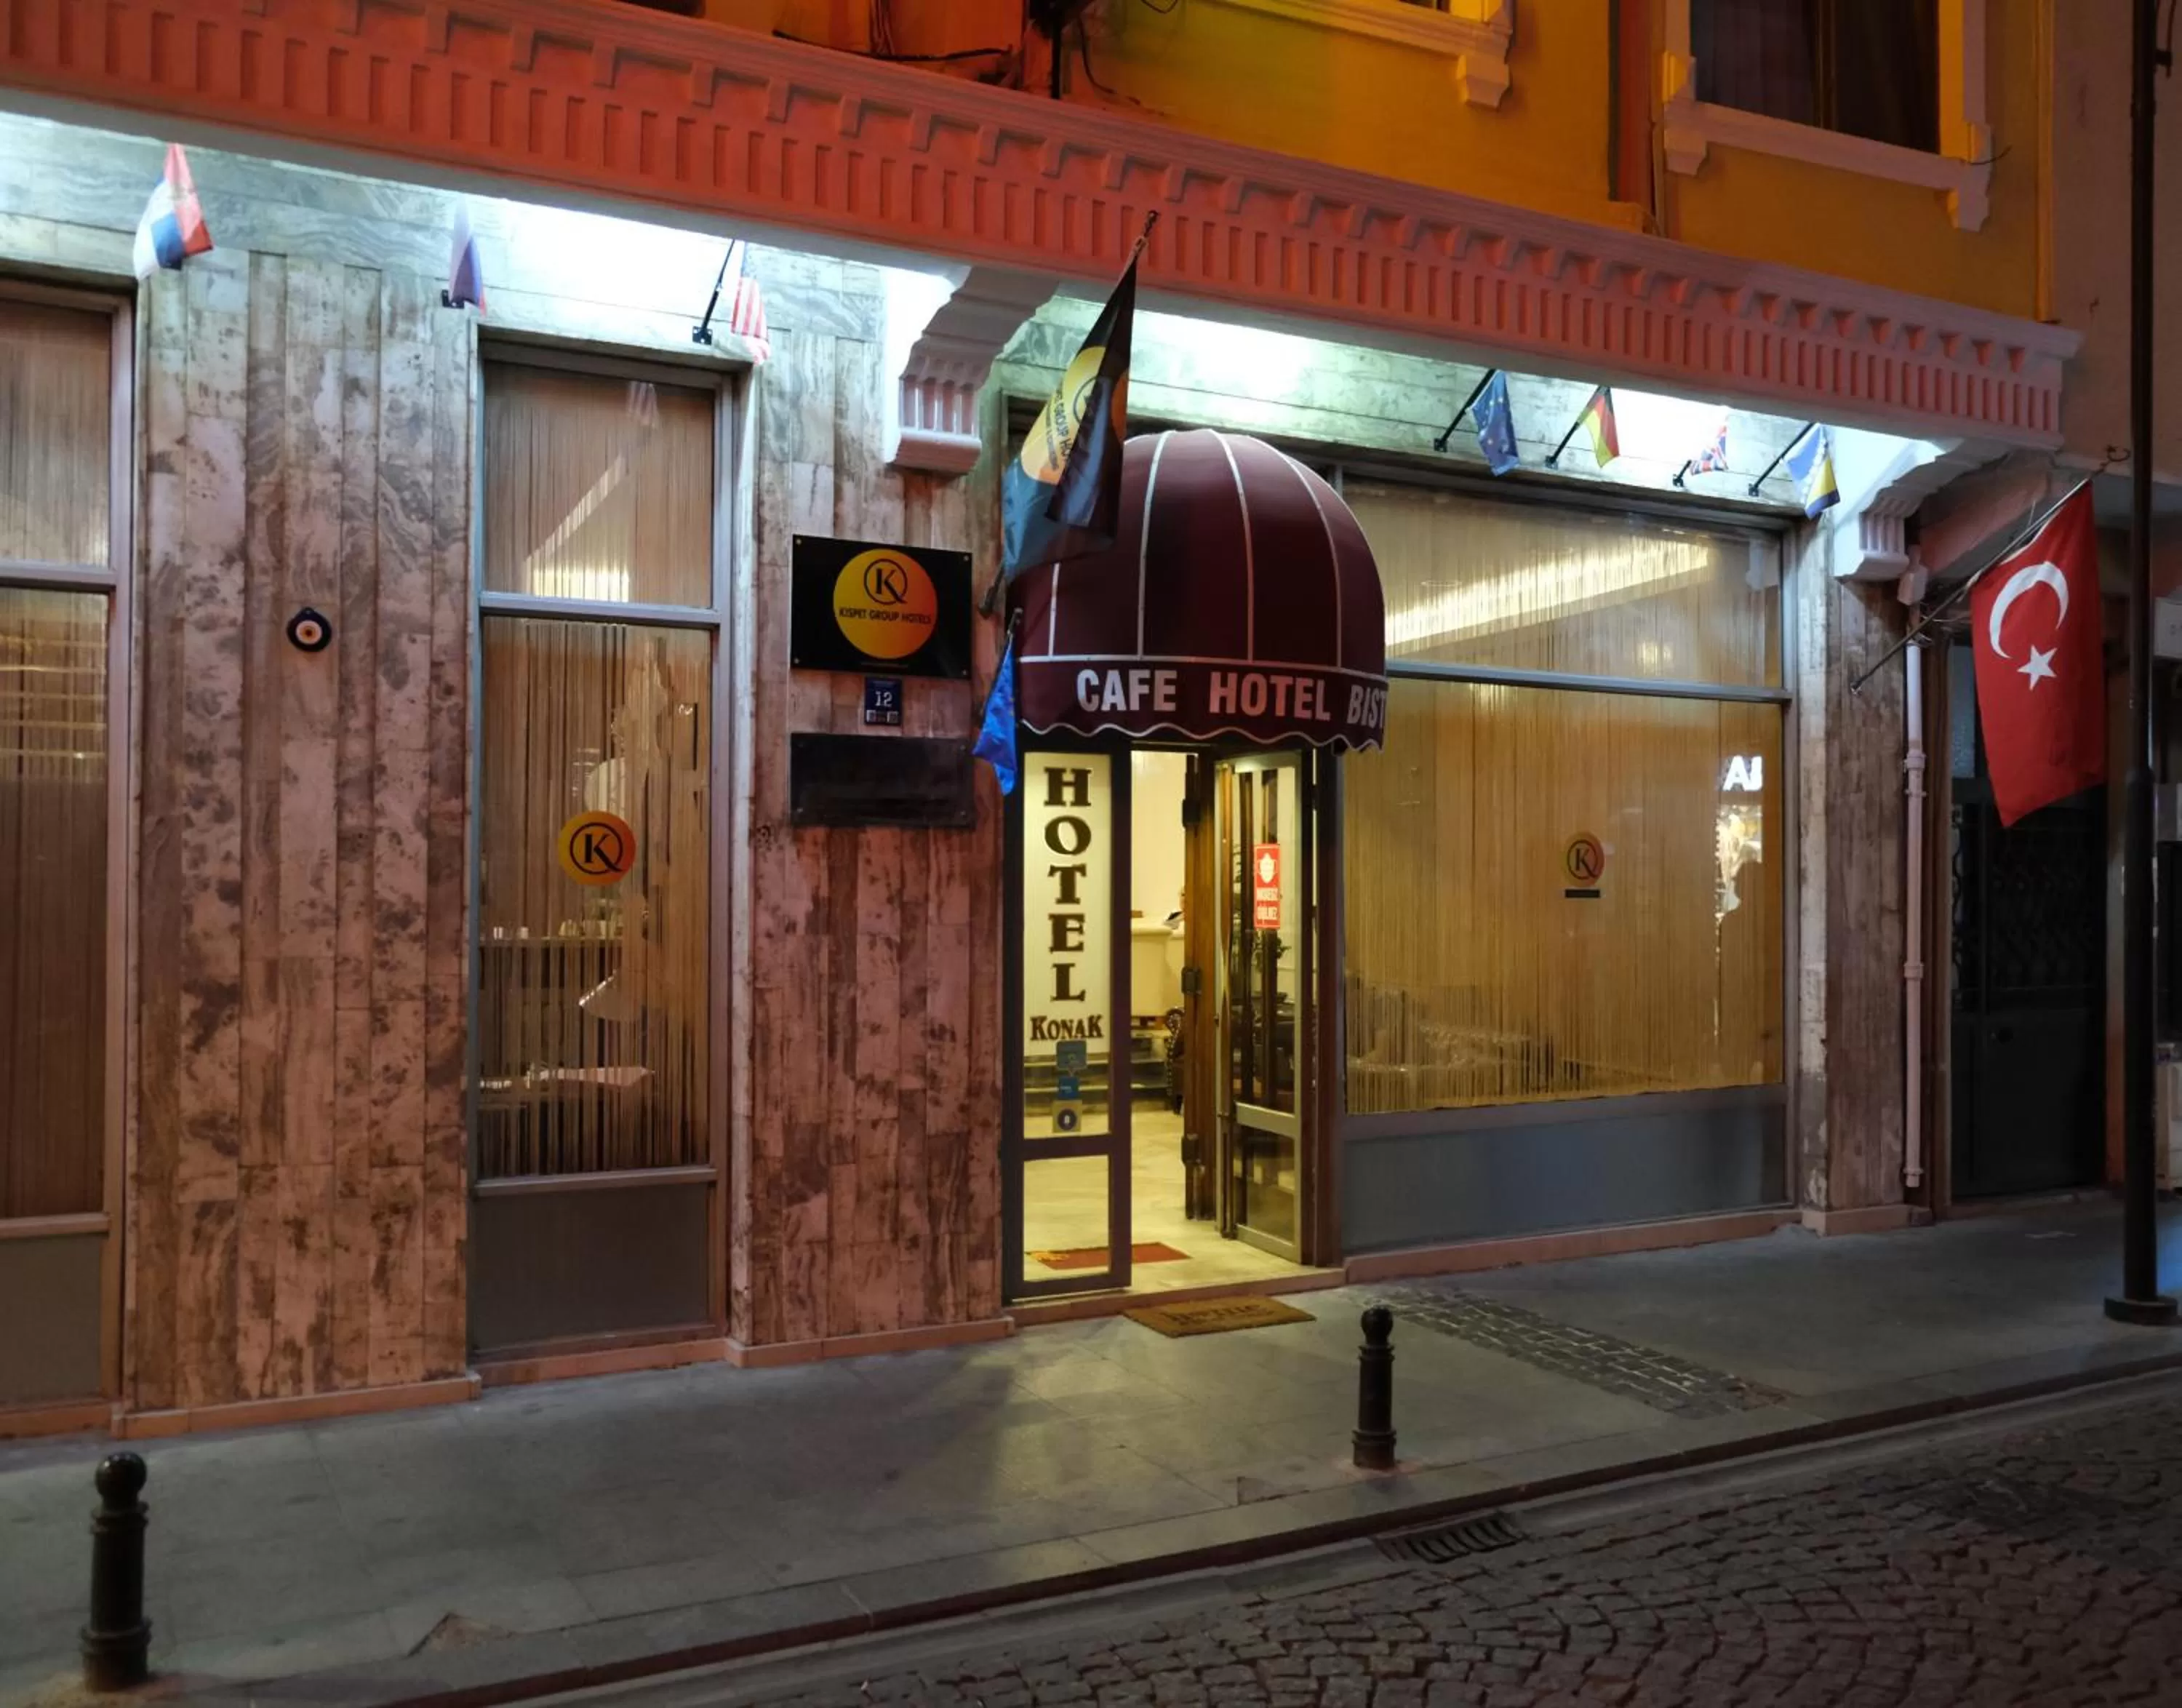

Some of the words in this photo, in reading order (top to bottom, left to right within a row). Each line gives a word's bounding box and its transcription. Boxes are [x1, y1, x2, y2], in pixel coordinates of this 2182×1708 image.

[869, 609, 900, 622] GROUP
[875, 690, 892, 707] 12
[1076, 669, 1178, 712] CAFE
[1209, 671, 1331, 722] HOTEL
[1044, 767, 1092, 1002] HOTEL
